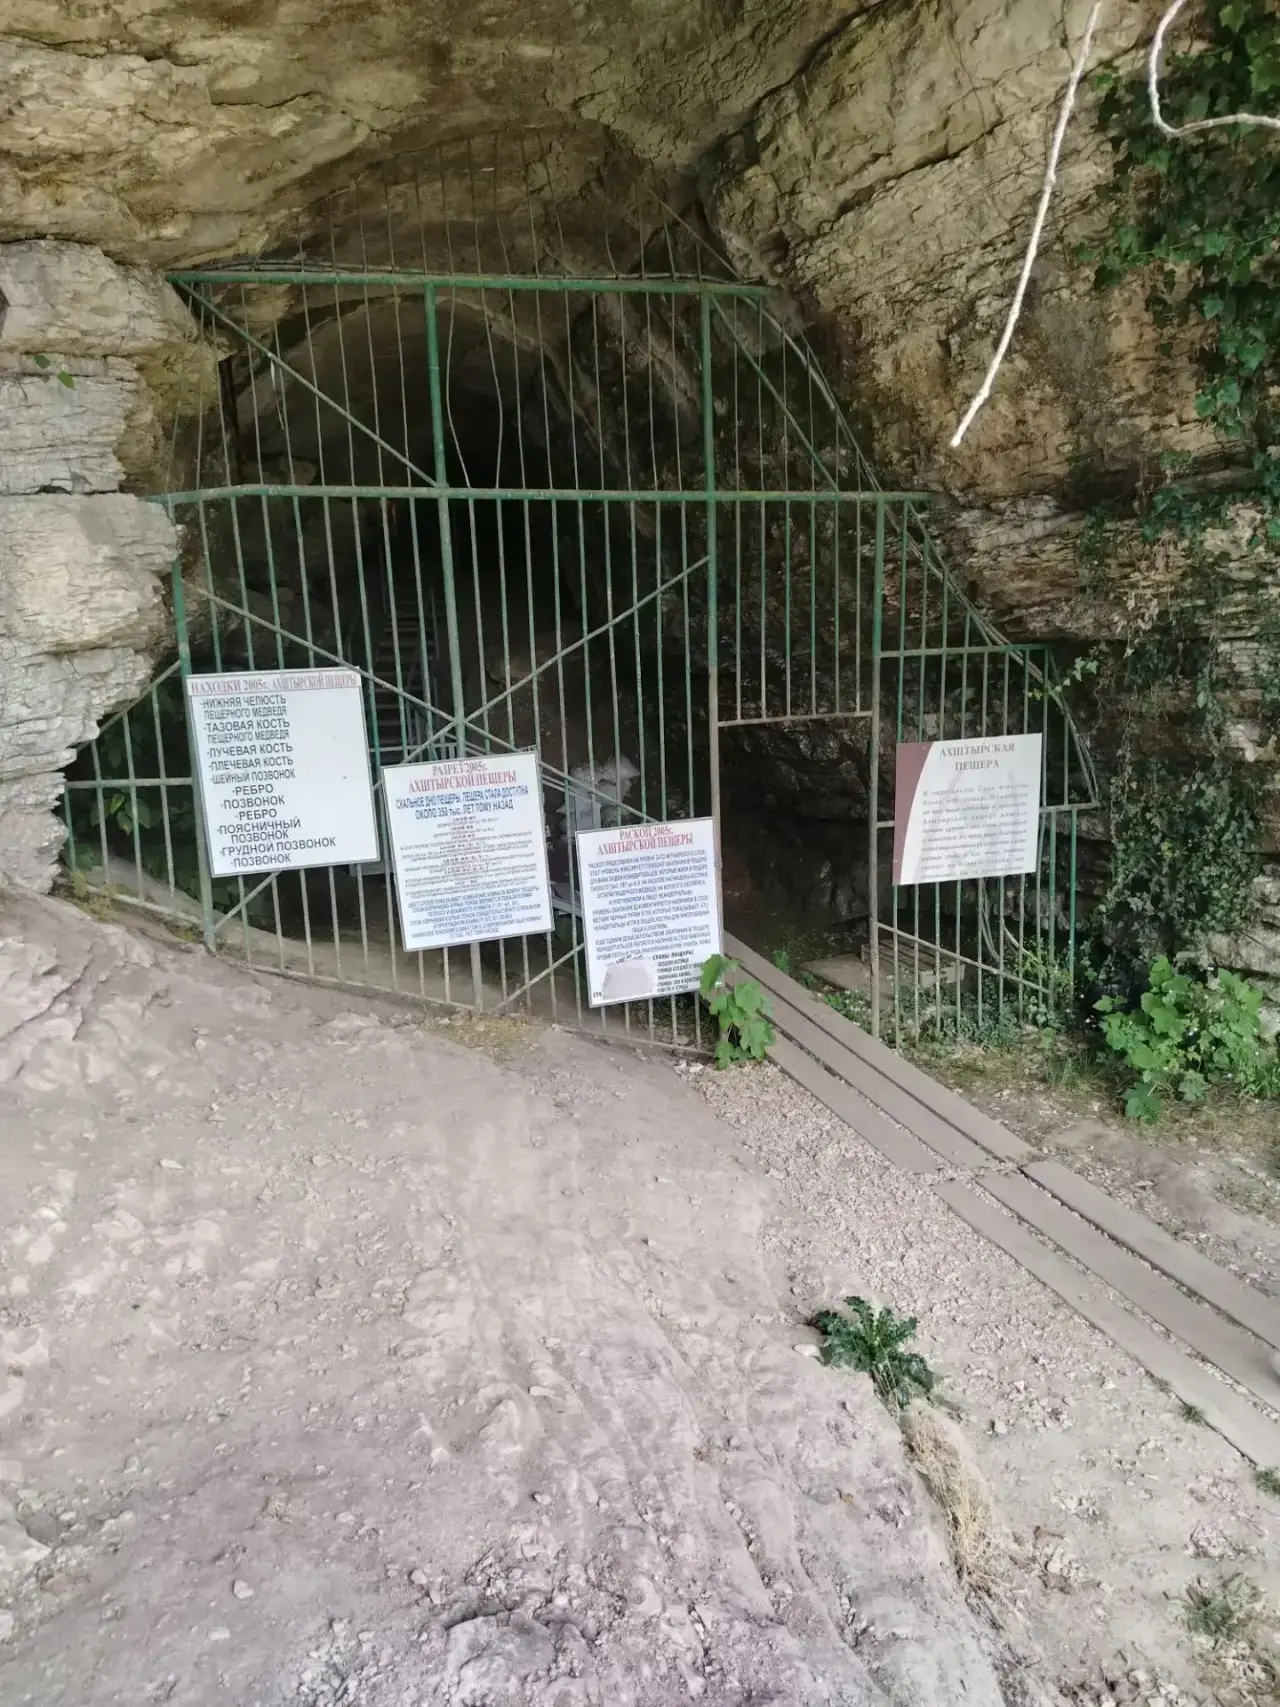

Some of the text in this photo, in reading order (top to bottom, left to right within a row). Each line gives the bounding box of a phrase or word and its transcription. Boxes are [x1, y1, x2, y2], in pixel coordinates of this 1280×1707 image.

[191, 680, 241, 694] НАХОДКИ
[272, 675, 324, 689] АХШТЫРСКОЙ
[325, 673, 357, 686] ПЕЩЕРЫ
[200, 695, 286, 708] -НИЖНЯЯ ЧЕЛЮСТЬ
[204, 706, 287, 720] ПЕЩЕРНОГО МЕДВЕДЯ
[203, 718, 290, 733] -ТАЗОВАЯ КОСТЬ
[208, 730, 290, 744] ПЕЩЕРНОГО МЕДВЕДЯ
[206, 743, 293, 758] -ЛУЧЕВАЯ КОСТЬ
[940, 743, 1015, 757] АХШТЫРСКАЯ
[208, 756, 293, 771] -ПЛЕЧЕВАЯ КОСТЬ
[432, 763, 464, 776] РАЗРЕЗ
[955, 759, 999, 771] ПЕЩЕРА
[210, 769, 295, 784] -ШЕЙНЫЙ ПОЗВОНОК
[408, 770, 517, 793] АХШТЫРСКОЙ ПЕЩЕРЫ
[232, 784, 274, 796] -РЕБРО
[220, 795, 285, 810] -ПОЗВОНОК
[415, 808, 437, 820] ОКОЛО
[462, 804, 475, 815] ЛЕТ
[476, 802, 492, 813] ТОМУ
[492, 800, 514, 812] НАЗАД
[235, 809, 278, 821] -РЕБРО
[216, 818, 301, 835] -ПОЯСНИЧНЫЙ
[620, 828, 650, 840] РАСКОП
[231, 830, 289, 844] ПОЗВОНОК
[598, 832, 693, 855] АХШТЫРСКОЙ ПЕЩЕРЫ
[219, 837, 336, 857] -ГРУДНОЙ ПОЗВОНОК
[231, 853, 291, 868] -ПОЗВОНОК
